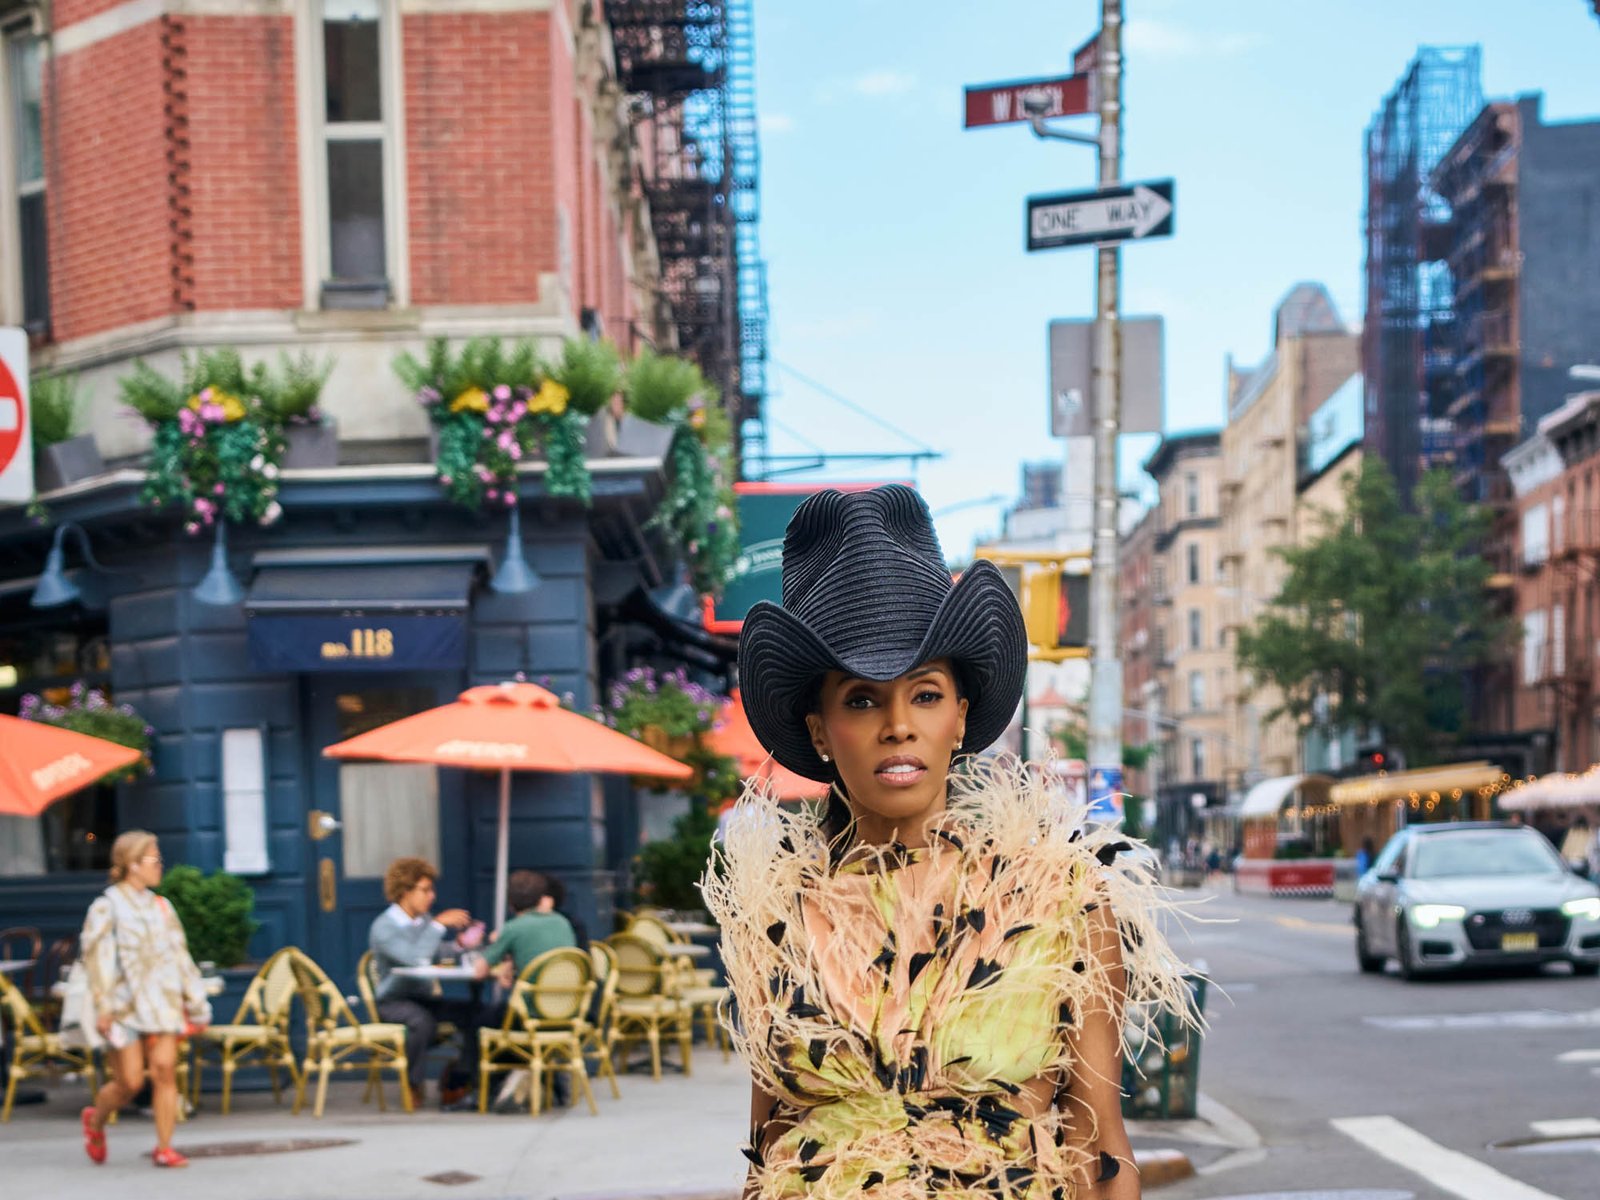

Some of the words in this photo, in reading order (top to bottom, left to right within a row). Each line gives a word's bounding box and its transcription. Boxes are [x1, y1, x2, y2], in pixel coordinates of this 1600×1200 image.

[992, 91, 1012, 121] W
[1038, 208, 1079, 233] ONE
[1107, 200, 1150, 223] WAY
